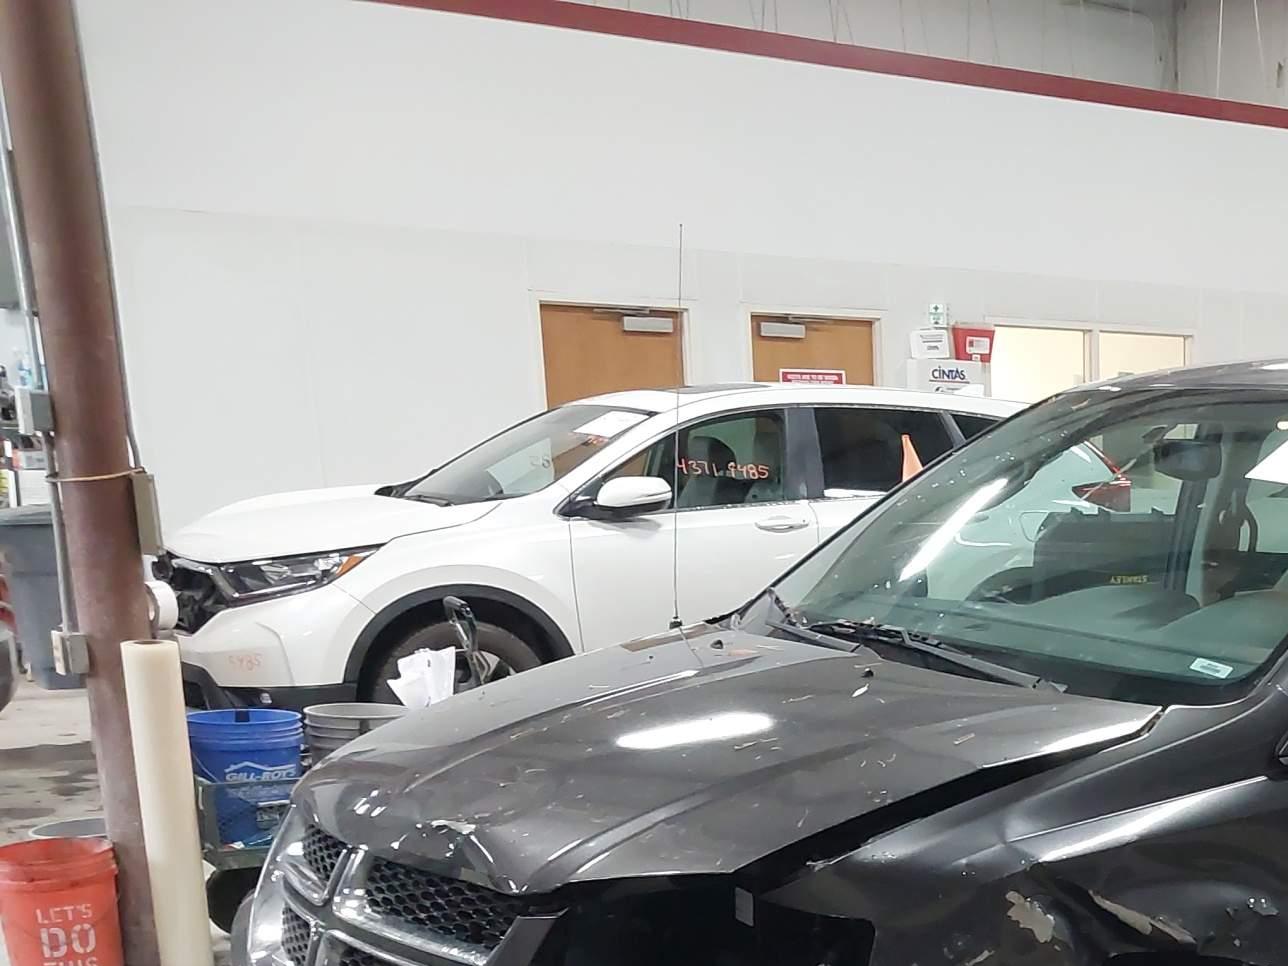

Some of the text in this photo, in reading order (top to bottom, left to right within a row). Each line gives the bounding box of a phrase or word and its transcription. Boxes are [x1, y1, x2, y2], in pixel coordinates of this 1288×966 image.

[931, 365, 966, 380] CINTAS
[36, 903, 93, 924] LET'S
[40, 923, 96, 958] DO
